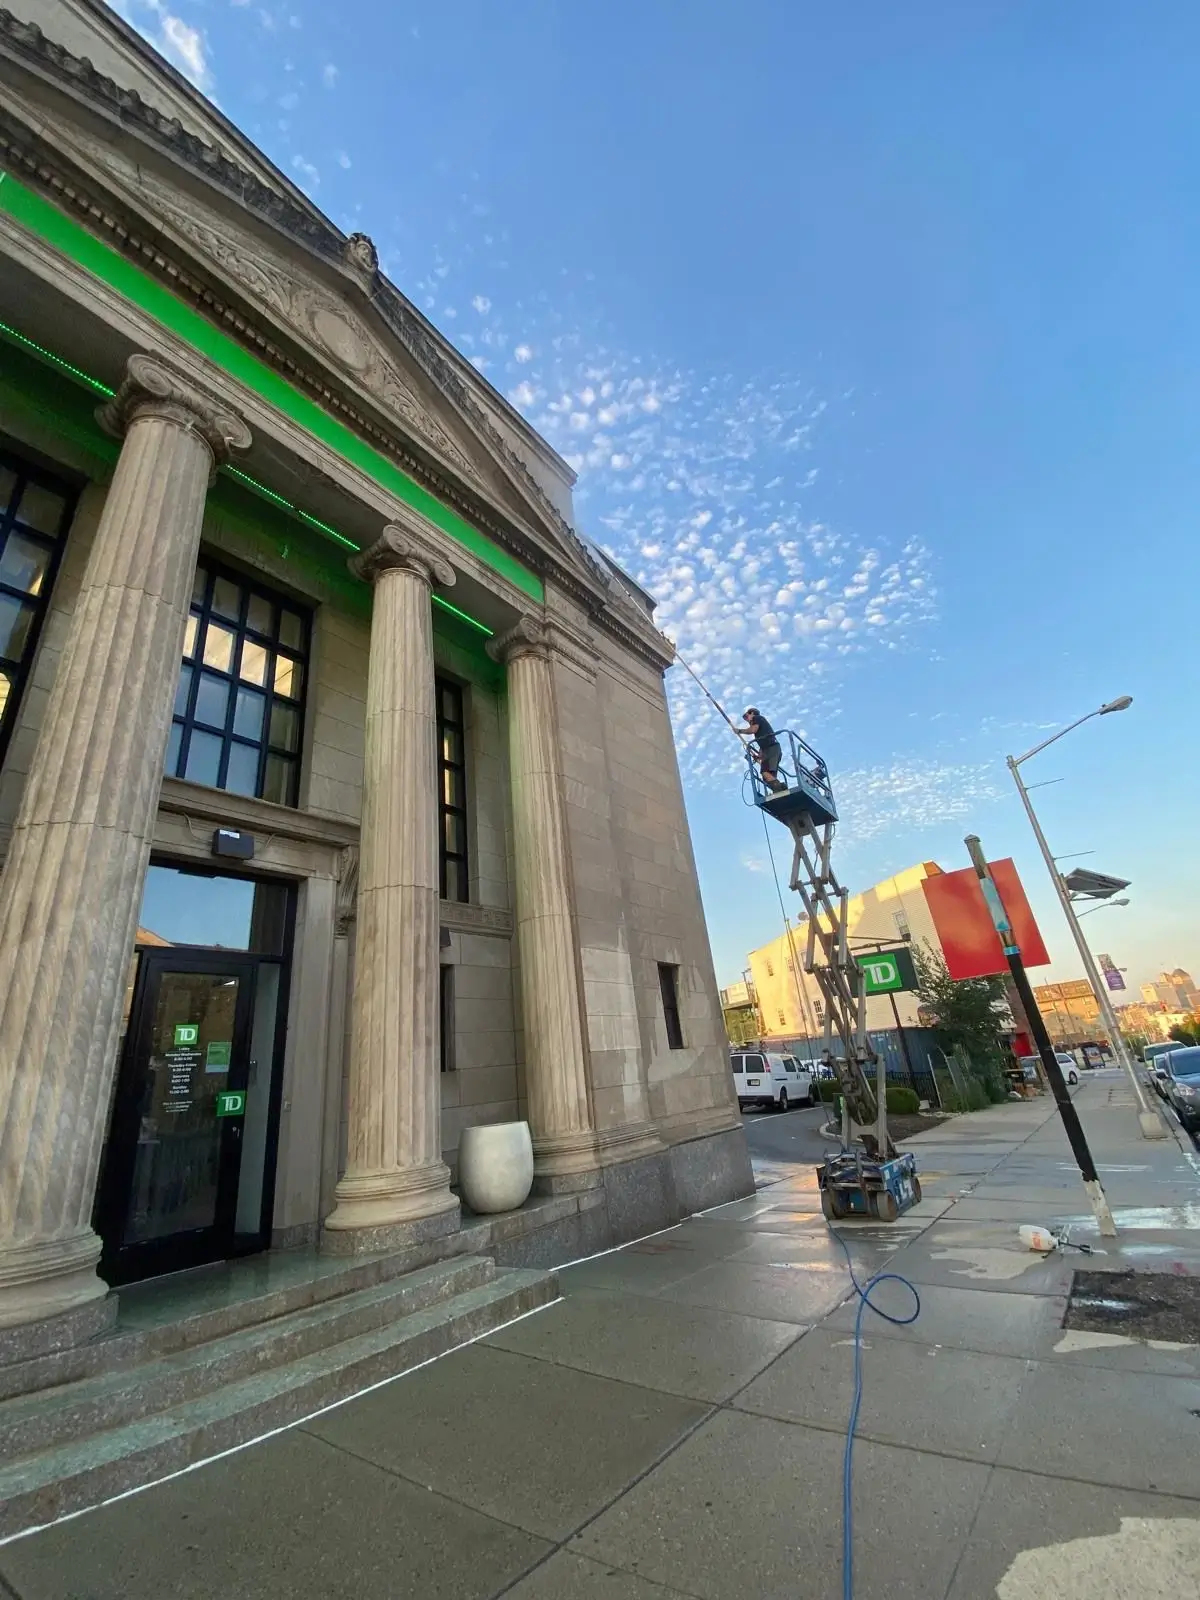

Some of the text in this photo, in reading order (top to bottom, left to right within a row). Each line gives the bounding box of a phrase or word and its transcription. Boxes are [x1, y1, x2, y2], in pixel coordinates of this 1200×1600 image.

[863, 961, 896, 984] TD
[178, 1028, 196, 1041] TD
[221, 1096, 242, 1111] TD
